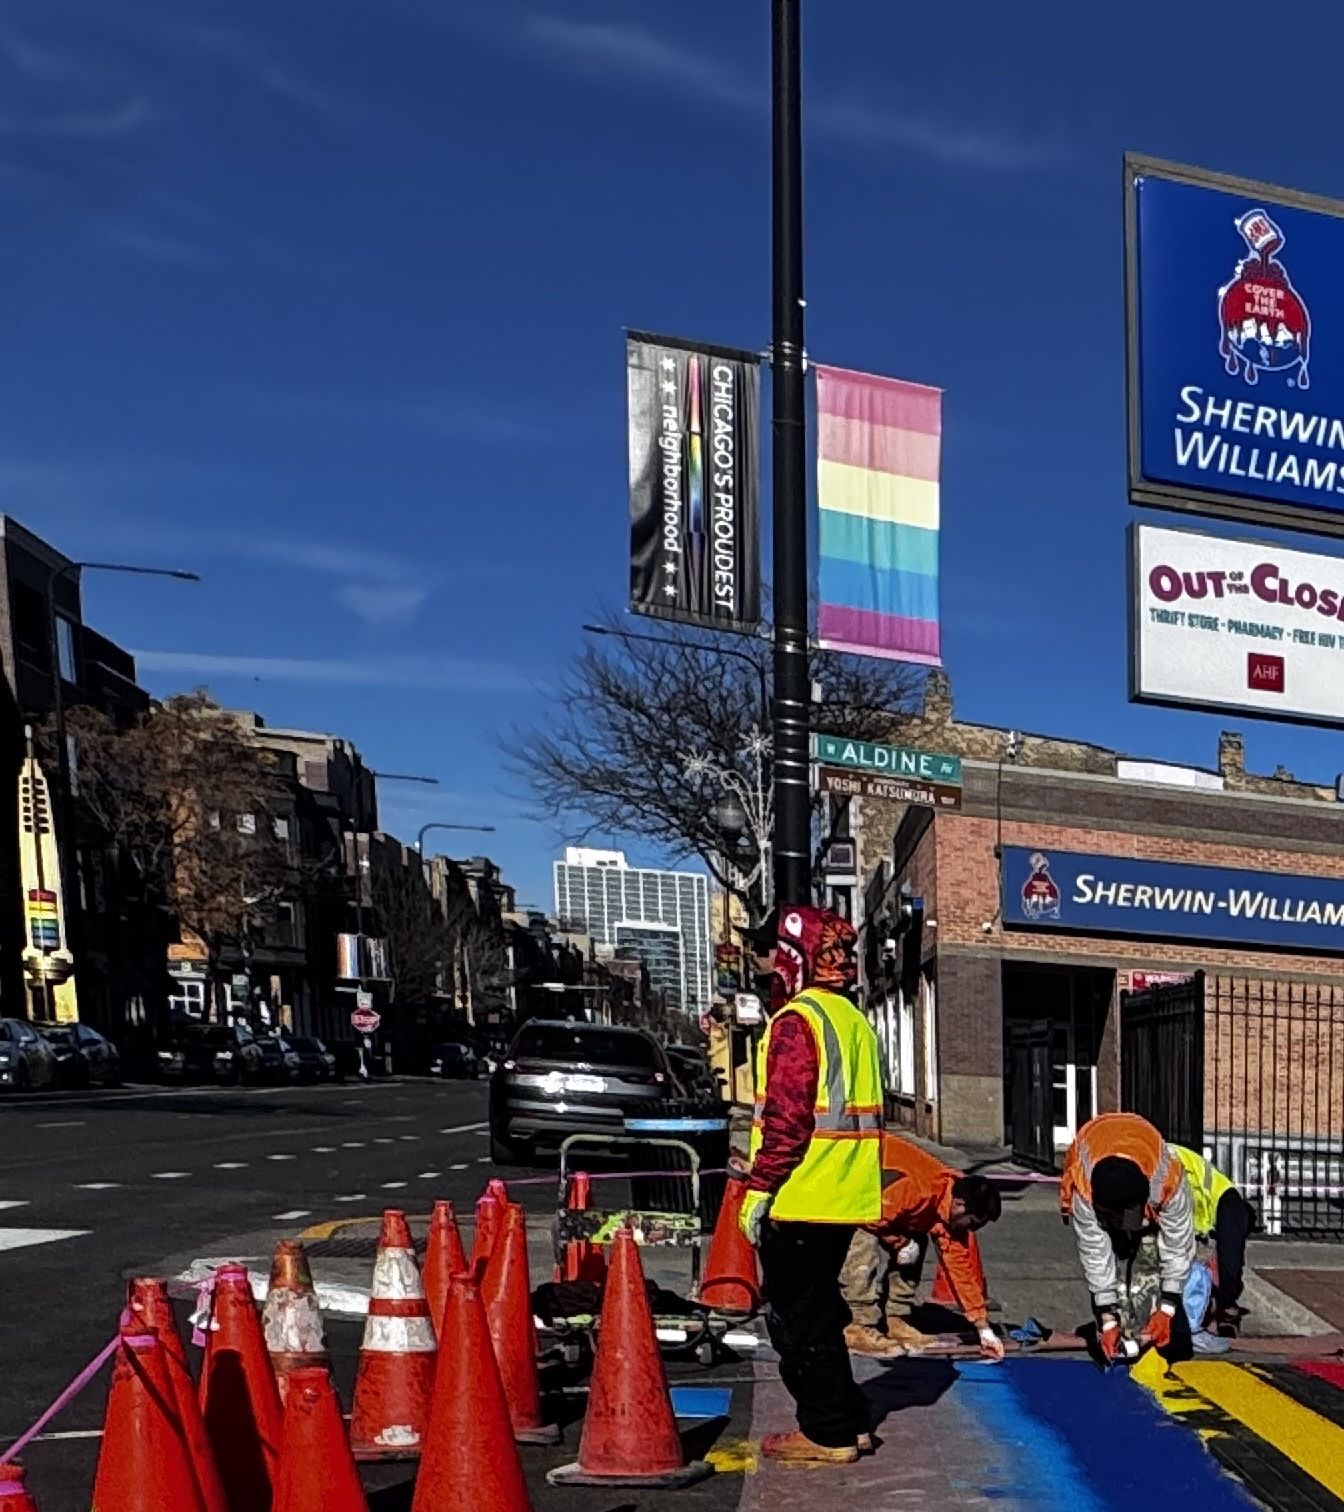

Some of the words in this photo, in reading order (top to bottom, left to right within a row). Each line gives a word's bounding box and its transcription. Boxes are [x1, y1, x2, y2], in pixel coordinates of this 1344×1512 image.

[712, 365, 734, 491] CHICAGO'S
[658, 405, 683, 552] neighborhood
[712, 493, 734, 613] PROUDEST
[1149, 564, 1227, 602] OUT
[1227, 584, 1250, 595] THE
[1229, 571, 1245, 582] OF
[1149, 607, 1186, 627] THRIFT
[1188, 613, 1220, 632] STORE
[1227, 619, 1285, 642] PHARMACY
[1292, 628, 1317, 647] FREE
[1318, 632, 1337, 649] HIV
[1252, 664, 1280, 681] AHF
[841, 742, 934, 776] ALDINE
